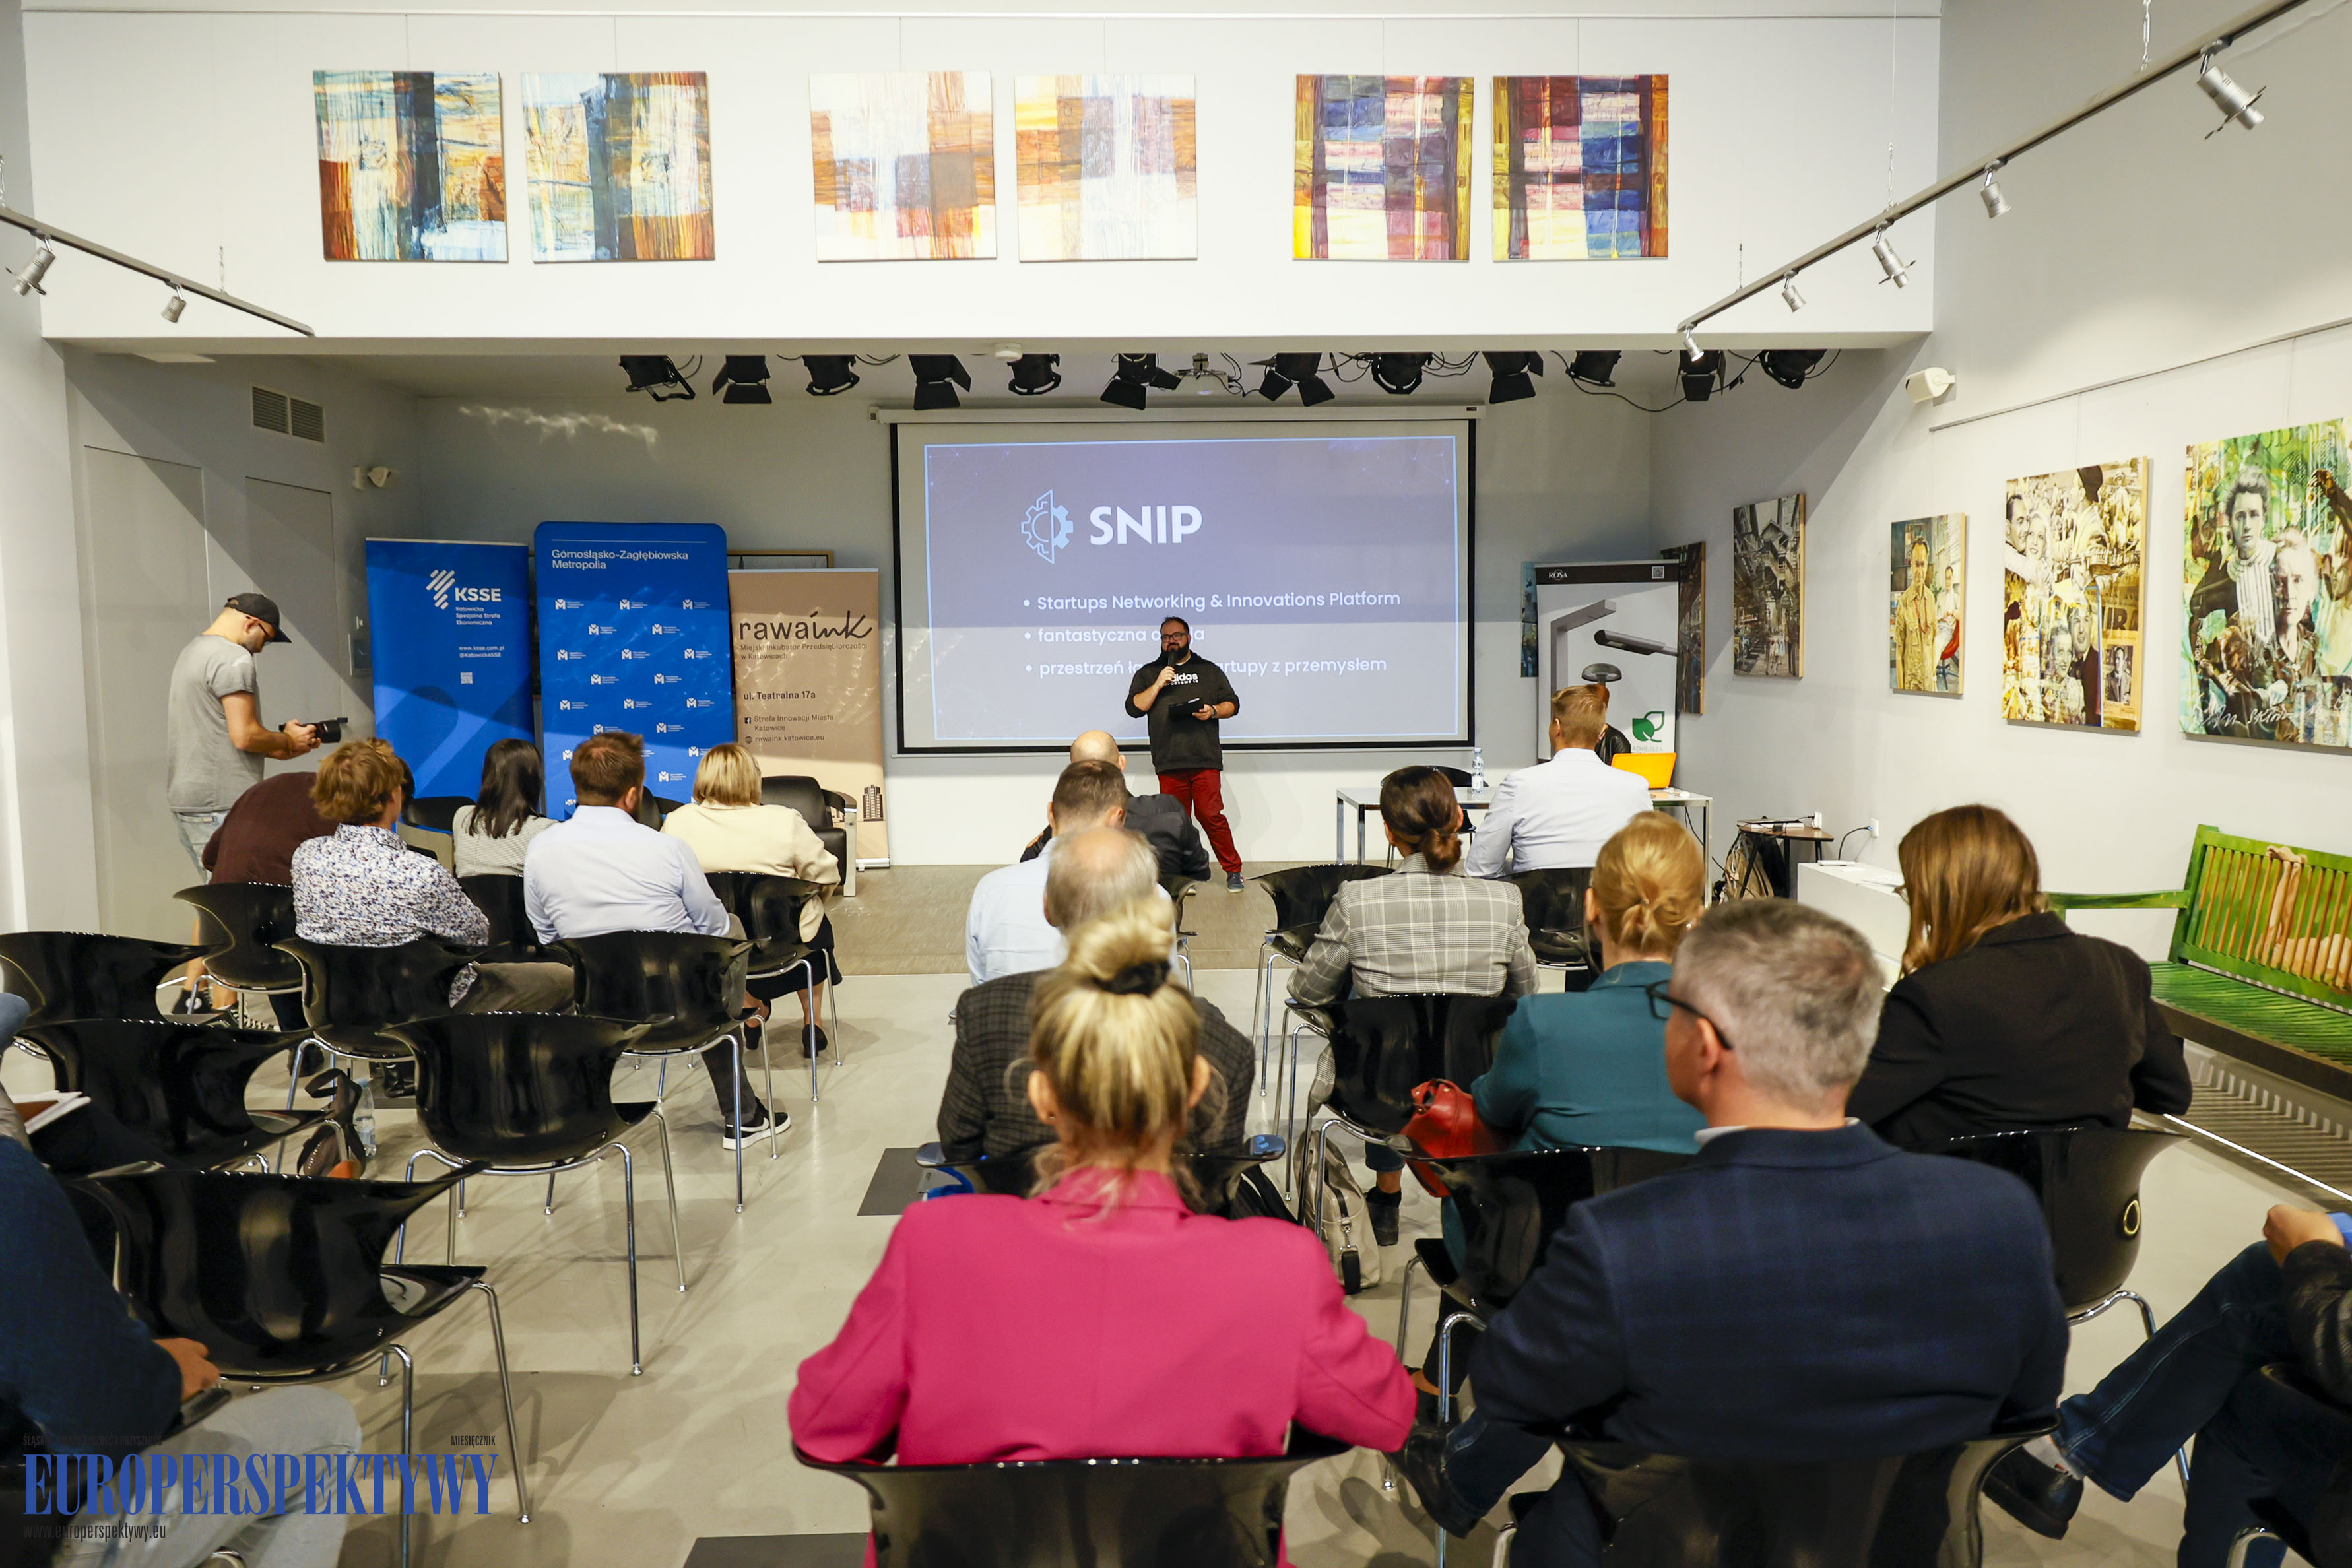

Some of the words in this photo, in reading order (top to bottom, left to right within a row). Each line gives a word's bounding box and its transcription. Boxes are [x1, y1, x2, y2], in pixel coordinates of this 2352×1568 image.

[1090, 505, 1202, 545] SNIP
[551, 549, 688, 561] Górnośląsko-Zagłębiowska
[552, 560, 606, 570] Metropolia
[454, 587, 502, 602] KSSE
[1037, 596, 1107, 613] Startups
[1112, 594, 1206, 612] Networking
[1210, 594, 1223, 608] &
[1227, 592, 1325, 607] Innovations
[1330, 591, 1400, 606] Platform
[1038, 628, 1146, 645] fantastyczna
[1151, 627, 1204, 645] oja
[1039, 660, 1124, 678] przestrzeń
[1272, 661, 1280, 672] z
[1284, 657, 1387, 676] przemysłem
[756, 691, 799, 700] Teatralna
